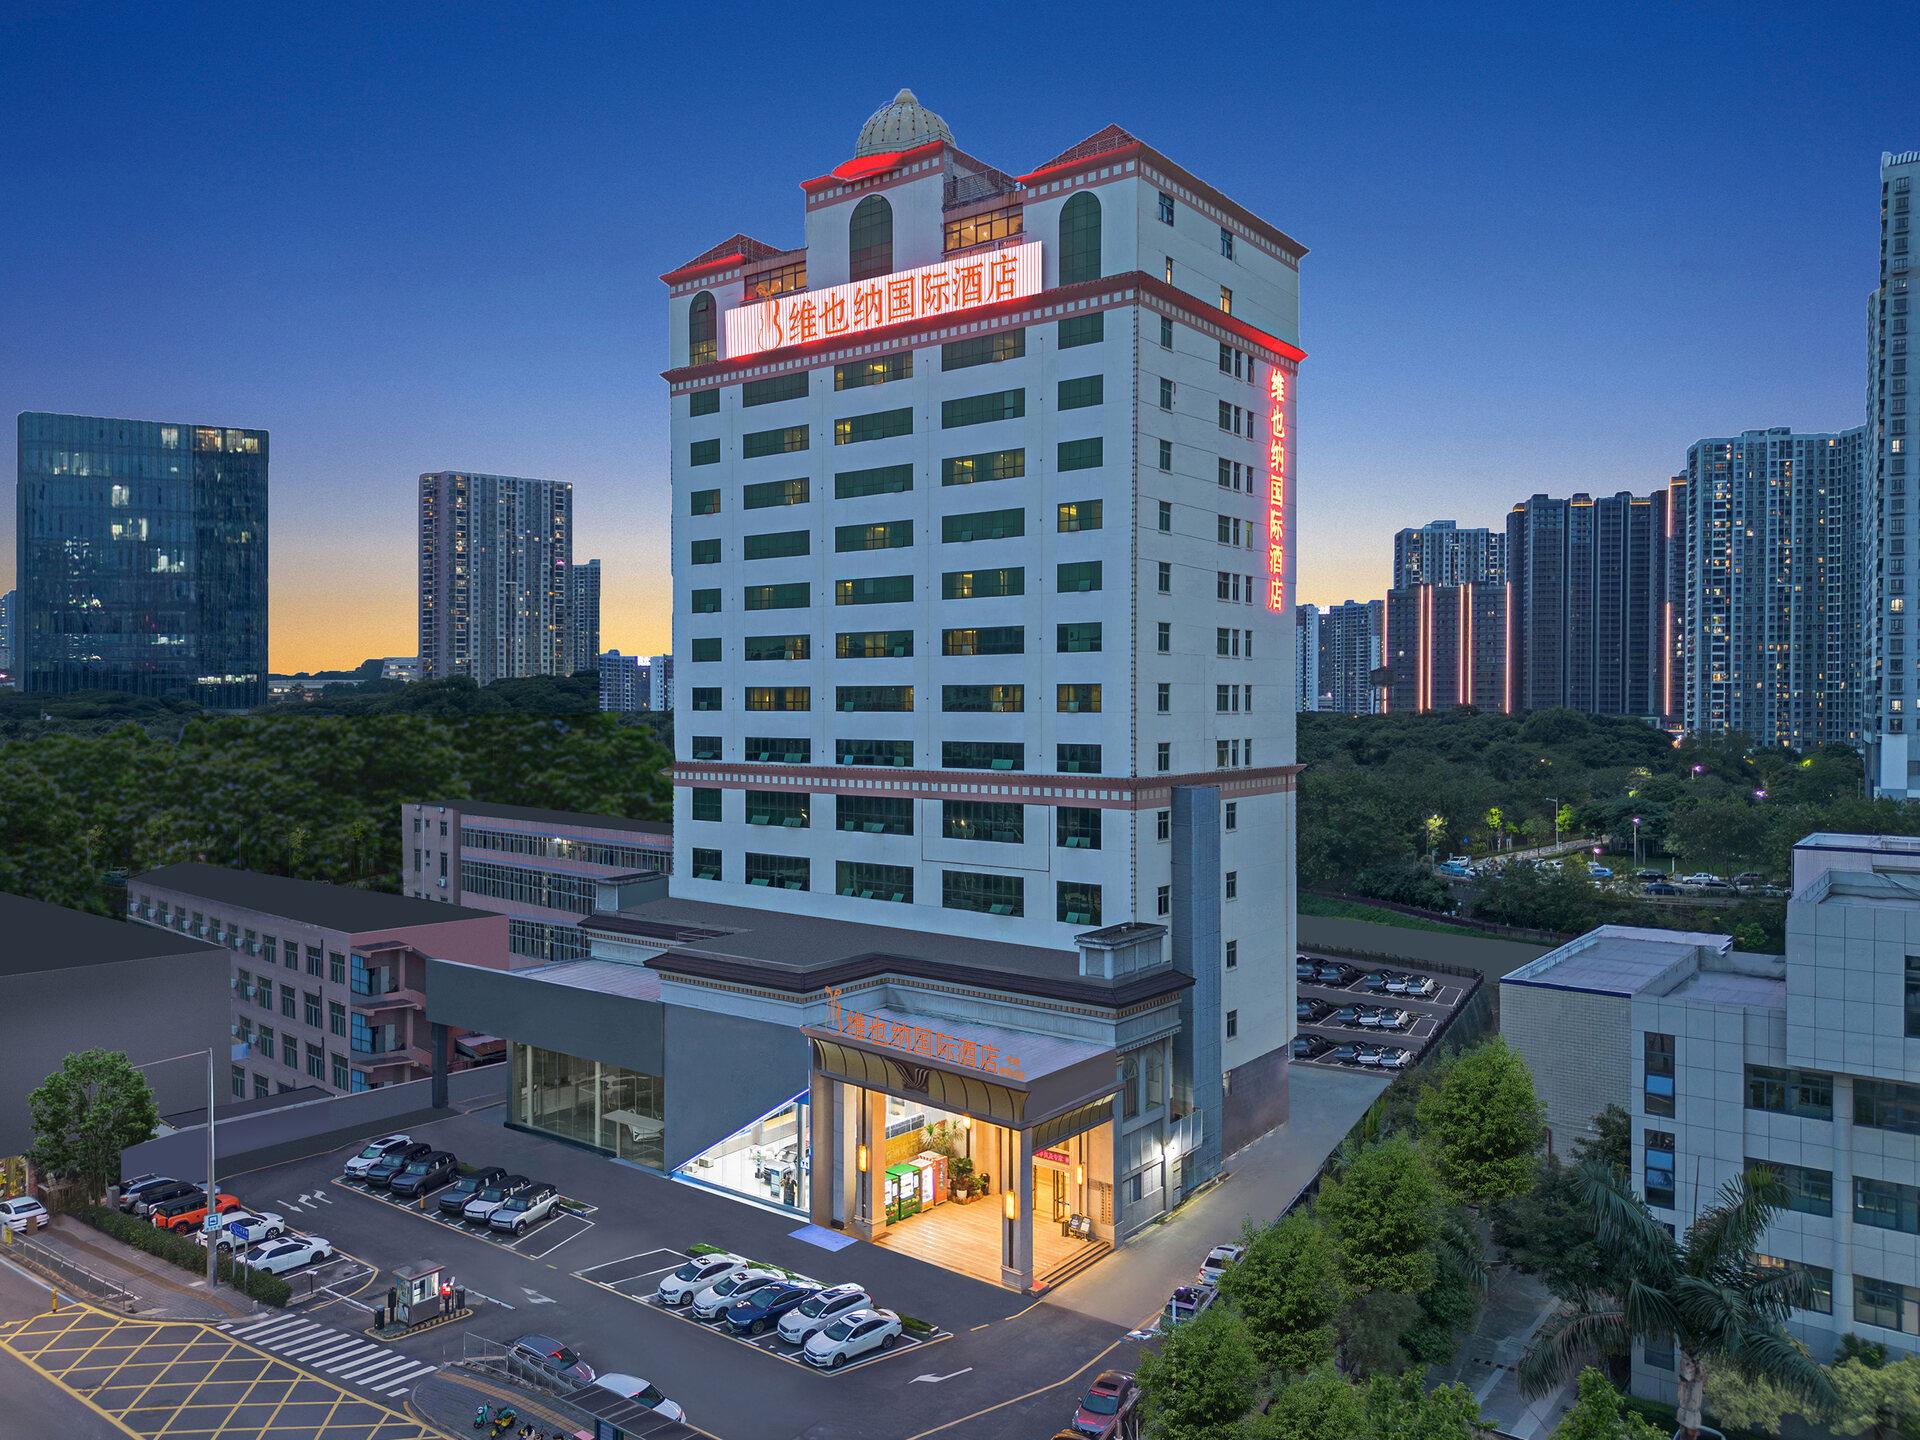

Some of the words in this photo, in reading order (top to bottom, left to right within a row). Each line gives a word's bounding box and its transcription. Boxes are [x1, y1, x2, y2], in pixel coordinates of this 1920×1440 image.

[788, 254, 1018, 342] 维也纳国际酒店
[1269, 368, 1285, 611] 维也纳国际酒店
[847, 1009, 1001, 1076] 维也纳国际酒店
